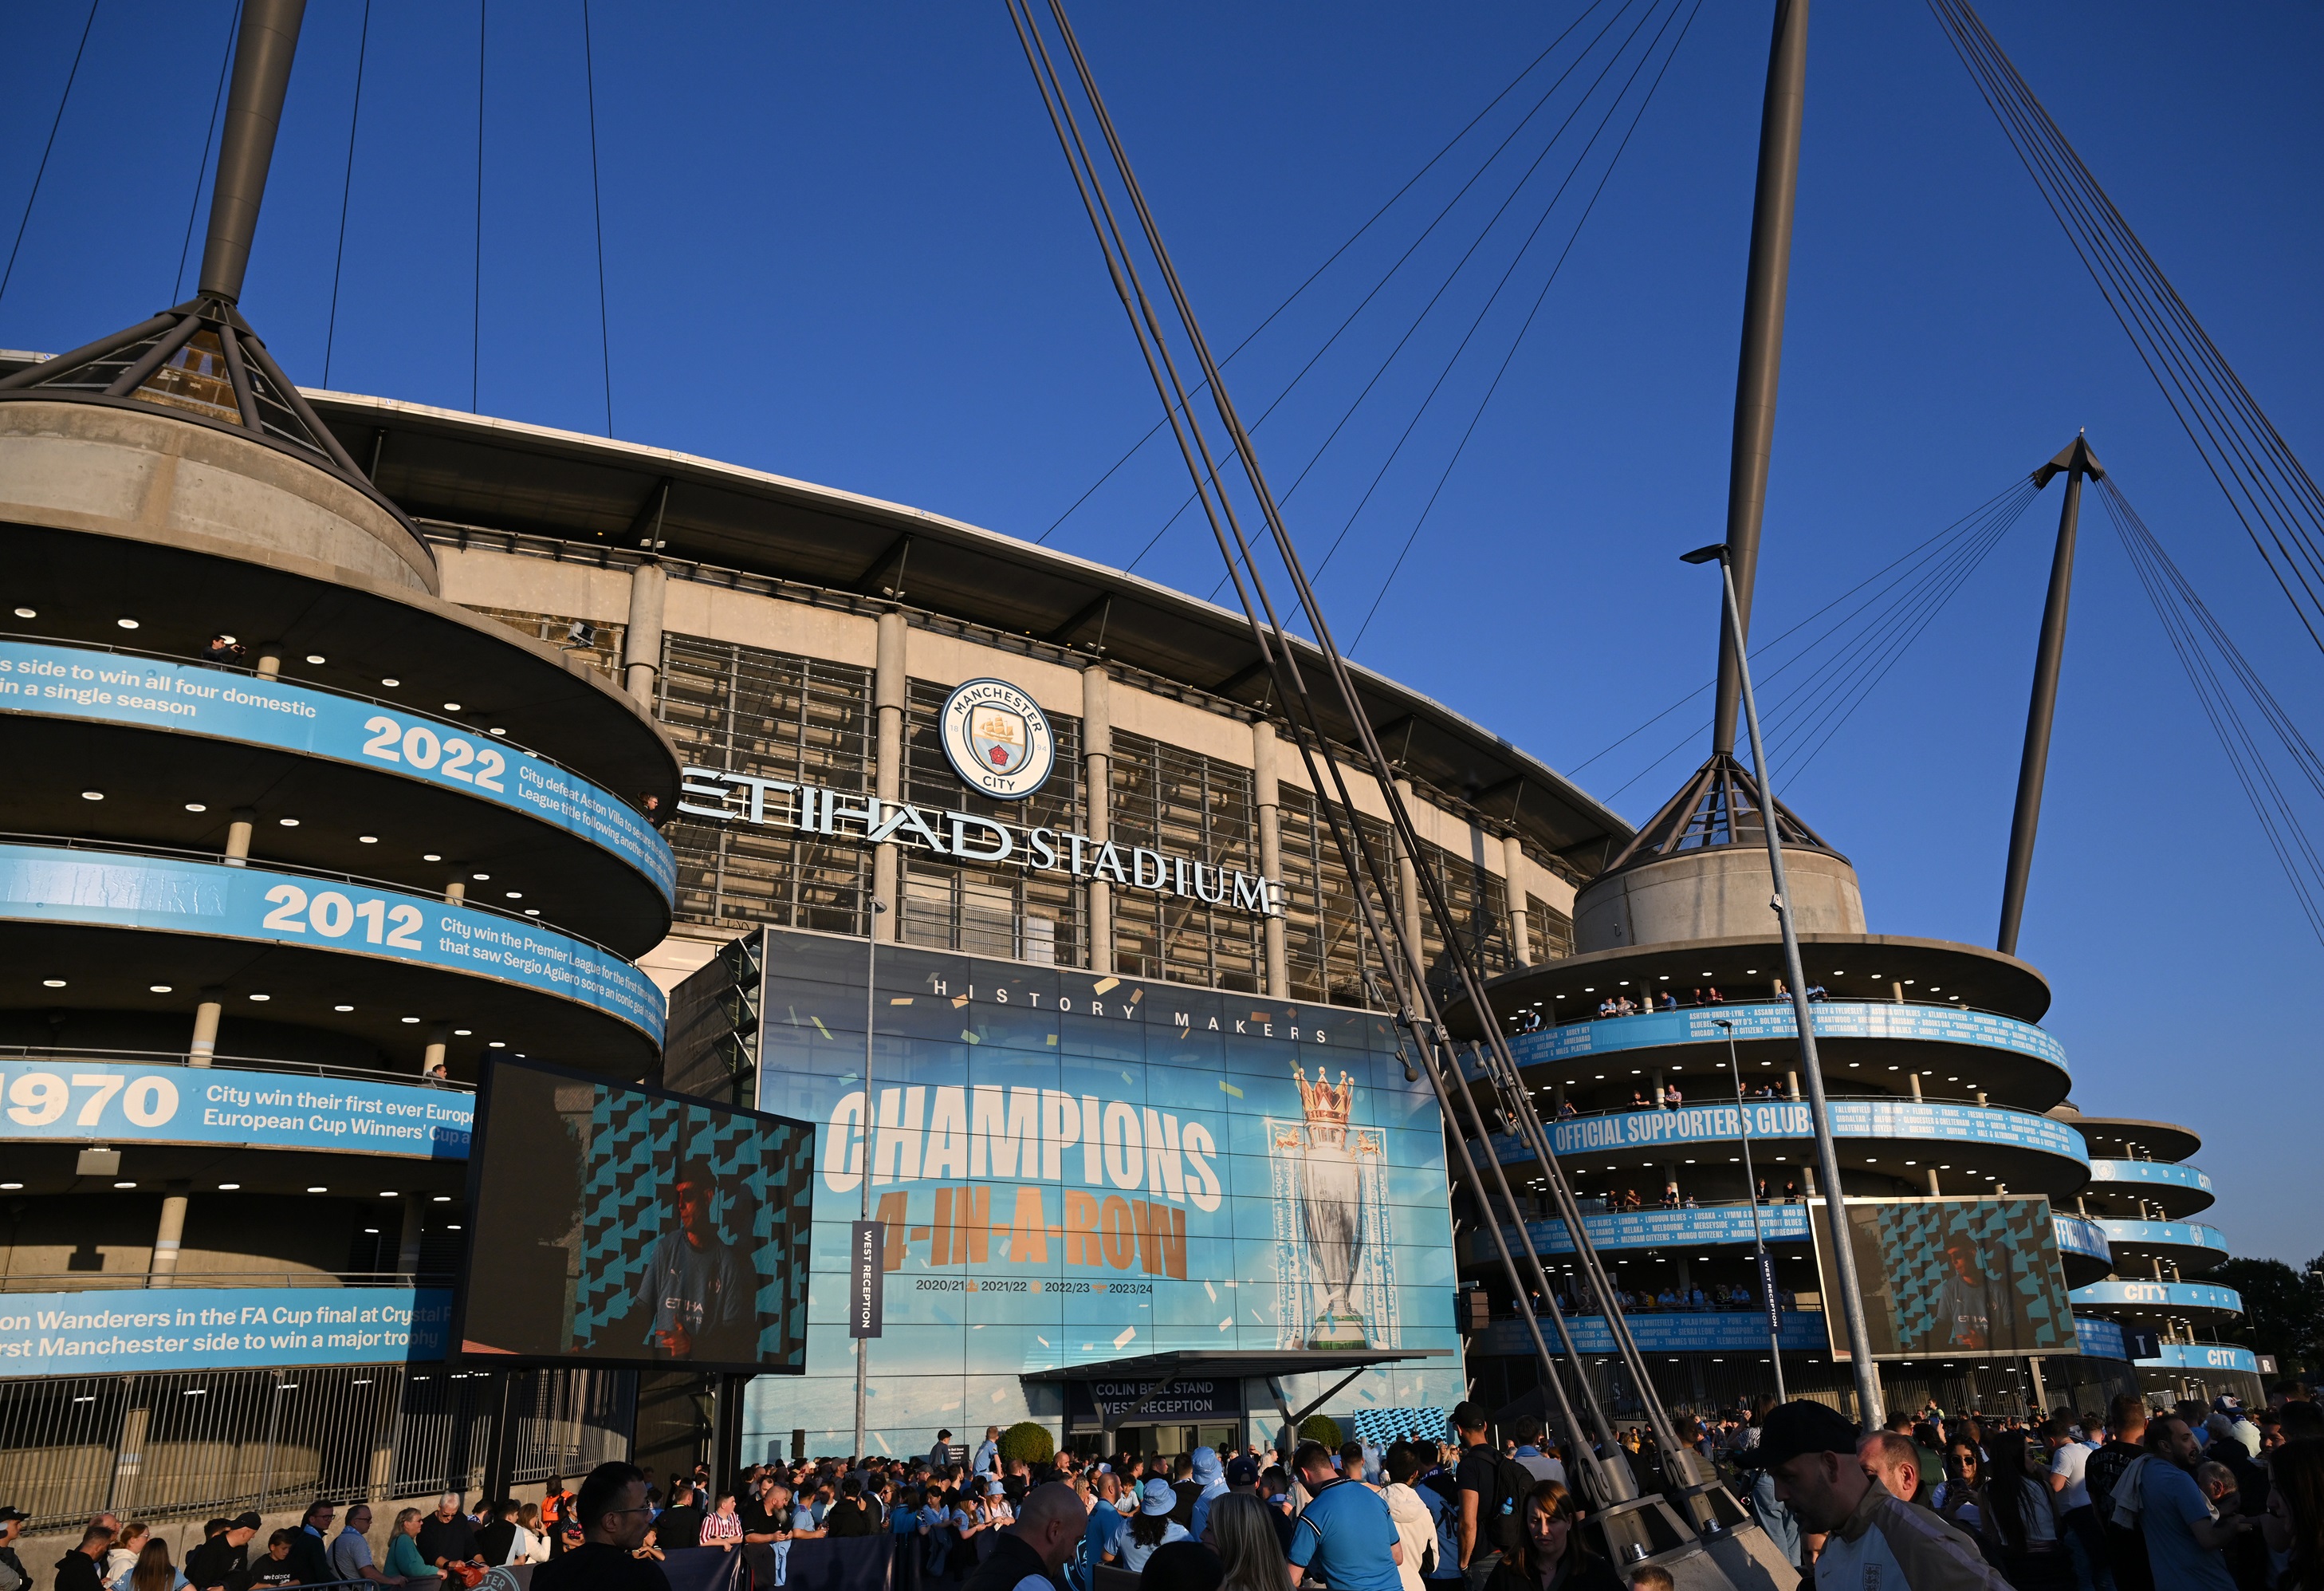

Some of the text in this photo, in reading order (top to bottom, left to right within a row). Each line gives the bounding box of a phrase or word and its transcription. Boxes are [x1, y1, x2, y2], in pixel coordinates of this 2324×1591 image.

[0, 678, 197, 717] in a single season
[18, 659, 67, 678] side
[70, 666, 94, 680] to
[99, 670, 140, 687] win
[146, 674, 171, 692] all
[175, 679, 219, 699] four
[222, 688, 317, 719] domestic
[954, 687, 1043, 732] MANCHESTER
[363, 715, 505, 794] 2022
[982, 775, 1016, 791] CITY
[518, 783, 560, 813] League
[561, 802, 581, 821] title
[582, 811, 620, 845] following
[620, 835, 644, 859] another
[520, 766, 544, 789] City
[545, 778, 580, 802] defeat
[580, 794, 607, 817] Aston
[608, 806, 624, 828] Villa
[624, 818, 632, 833] to
[632, 826, 651, 848] secure
[677, 767, 1272, 915] ETIHAD STADIUM
[262, 884, 423, 951] 2012
[441, 917, 471, 939] City
[474, 927, 498, 943] win
[501, 931, 521, 949] the
[524, 937, 568, 963] Premier
[569, 951, 601, 975] League
[601, 965, 613, 980] for
[613, 971, 624, 986] the
[624, 976, 638, 994] first
[439, 937, 470, 956] that
[472, 947, 501, 963] saw
[503, 951, 542, 975] Sergio
[543, 963, 580, 986] Agüero
[580, 978, 604, 995] score
[605, 988, 615, 1002] an
[615, 990, 634, 1009] iconic
[633, 1002, 644, 1016] goal
[934, 979, 1327, 1044] HISTORY MAKERS
[1689, 1010, 1744, 1020] ASHTON-UNDER-LYNE
[1691, 1029, 1714, 1038] CHICAGO
[206, 1085, 250, 1107] City
[254, 1089, 293, 1107] win
[297, 1090, 343, 1110] their
[344, 1093, 383, 1114] first
[386, 1101, 423, 1117] ever
[203, 1109, 305, 1131] European
[308, 1116, 347, 1136] Cup
[350, 1118, 427, 1140] Winners'
[428, 1126, 459, 1146] Cup
[1555, 1118, 1625, 1151] OFFICIAL
[1627, 1107, 1752, 1142] SUPPORTERS
[1909, 1125, 1935, 1134] GUERNSEY
[1940, 1117, 1970, 1126] CHELTENHAM
[824, 1085, 1221, 1212] CHAMPIONS
[1275, 1164, 1284, 1203] League
[1369, 1172, 1378, 1209] League
[1379, 1173, 1390, 1253] Premier League
[1618, 1216, 1638, 1225] LONDON
[1694, 1211, 1716, 1220] LUSAKA
[1724, 1211, 1742, 1219] LYMM
[1748, 1209, 1774, 1219] DITRICT
[1622, 1218, 1803, 1235] MELAKA MELBOURNE MERSEYSIDE DETROIT BLUES
[874, 1186, 1187, 1282] 4-IN-A-ROW
[1621, 1231, 1724, 1244] MIZORAM CITYZENS CITYZENS
[2052, 1218, 2090, 1250] FFICIAL
[862, 1230, 872, 1329] WEST RECEPTION
[915, 1279, 1153, 1296] 2020/21 2021/22 2022/23 2023/24
[2124, 1284, 2168, 1302] CITY
[37, 1309, 171, 1330] Wanderers
[175, 1308, 196, 1326] in
[199, 1307, 237, 1326] the
[241, 1307, 269, 1325] FA
[272, 1306, 312, 1328] Cup
[316, 1305, 356, 1323] final
[360, 1307, 378, 1323] at
[381, 1305, 440, 1327] Crystal
[665, 1297, 704, 1314] ETIHA
[1767, 1283, 1777, 1327] RECEPTION
[38, 1336, 189, 1357] Manchester
[192, 1333, 239, 1352] side
[243, 1333, 265, 1350] to
[269, 1331, 309, 1349] win
[311, 1335, 324, 1349] a
[327, 1330, 382, 1350] major
[385, 1330, 438, 1353] trophy
[2135, 1335, 2146, 1355] T
[2207, 1349, 2236, 1366] CITY
[2262, 1360, 2272, 1372] R
[1096, 1383, 1135, 1396] COLIN
[1174, 1381, 1213, 1394] STAND
[1140, 1400, 1213, 1414] RECEPTION
